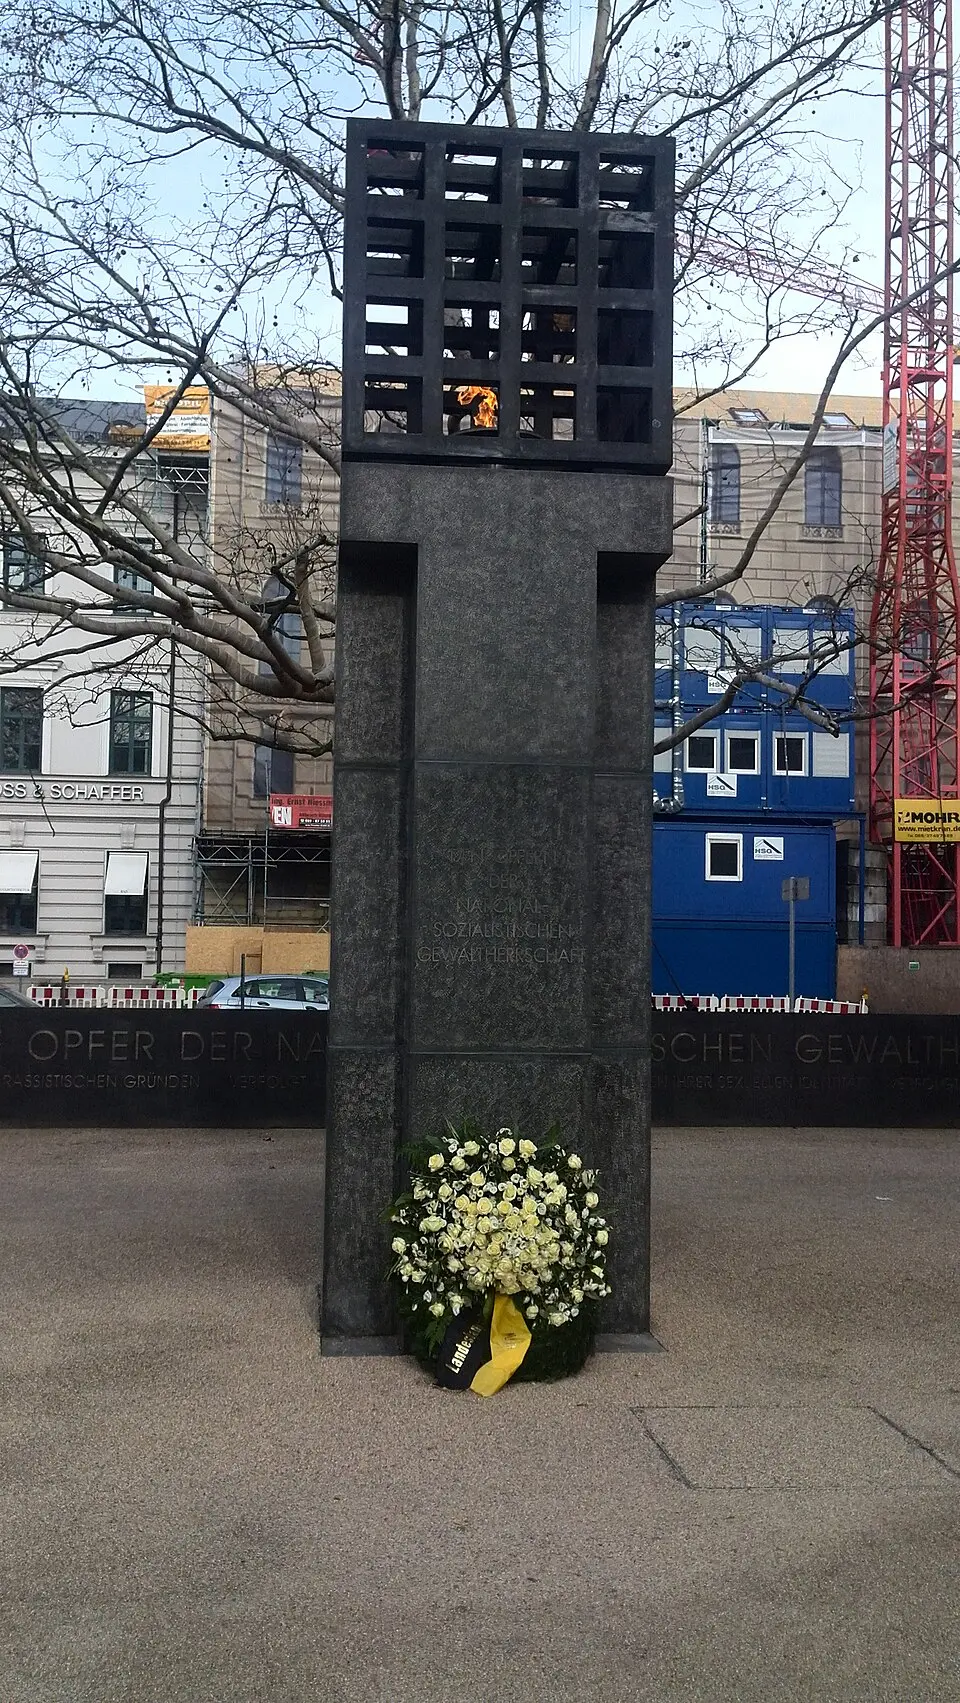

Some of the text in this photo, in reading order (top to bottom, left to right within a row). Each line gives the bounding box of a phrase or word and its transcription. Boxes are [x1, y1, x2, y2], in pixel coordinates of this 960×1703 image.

[0, 782, 143, 801] SS & SCHAFFER
[911, 812, 960, 823] MOHR
[432, 922, 572, 939] SOZIALISTISCHEN
[416, 946, 587, 963] GEWALTHERRSCHAFT
[28, 1029, 155, 1061] OPFER
[180, 1031, 253, 1061] DER
[123, 1071, 201, 1089] GRÜNDEN
